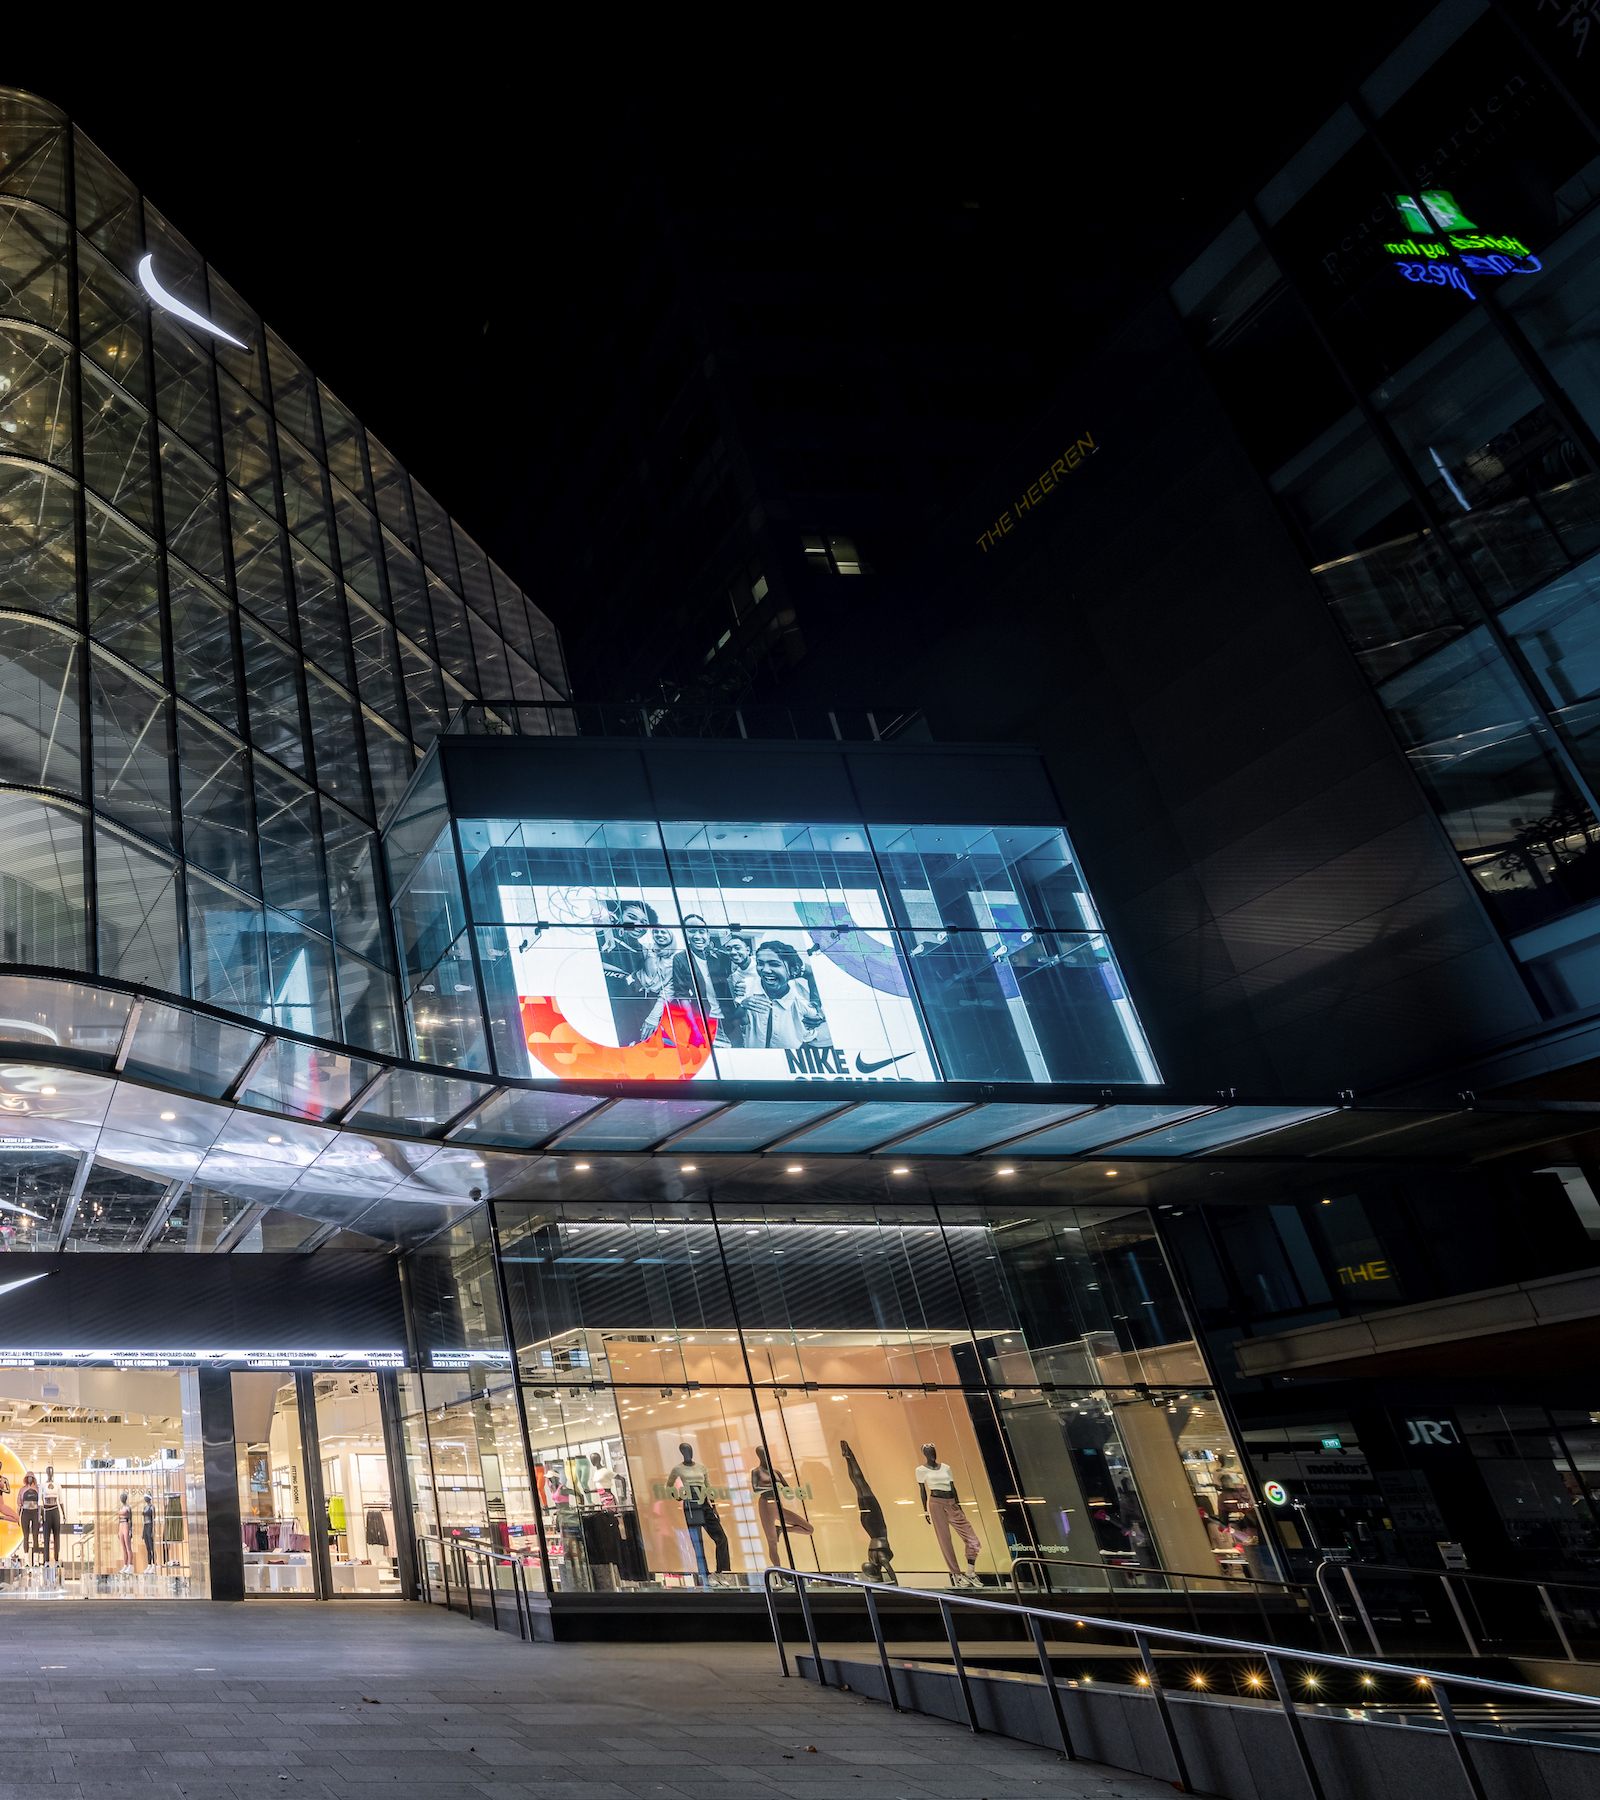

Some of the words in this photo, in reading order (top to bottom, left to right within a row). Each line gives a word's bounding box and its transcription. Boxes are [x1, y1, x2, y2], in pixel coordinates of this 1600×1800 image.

[1414, 74, 1528, 187] garden
[1437, 81, 1549, 189] estaurant
[976, 511, 1014, 552] THE
[1014, 431, 1096, 518] HEEREN
[784, 1048, 850, 1074] NIKE
[1337, 1260, 1390, 1285] THE
[1306, 1461, 1368, 1475] monitors
[652, 1482, 691, 1500] find
[693, 1486, 738, 1505] your
[1310, 1483, 1351, 1491] SAMSUNG
[1388, 1494, 1433, 1503] REWARDS
